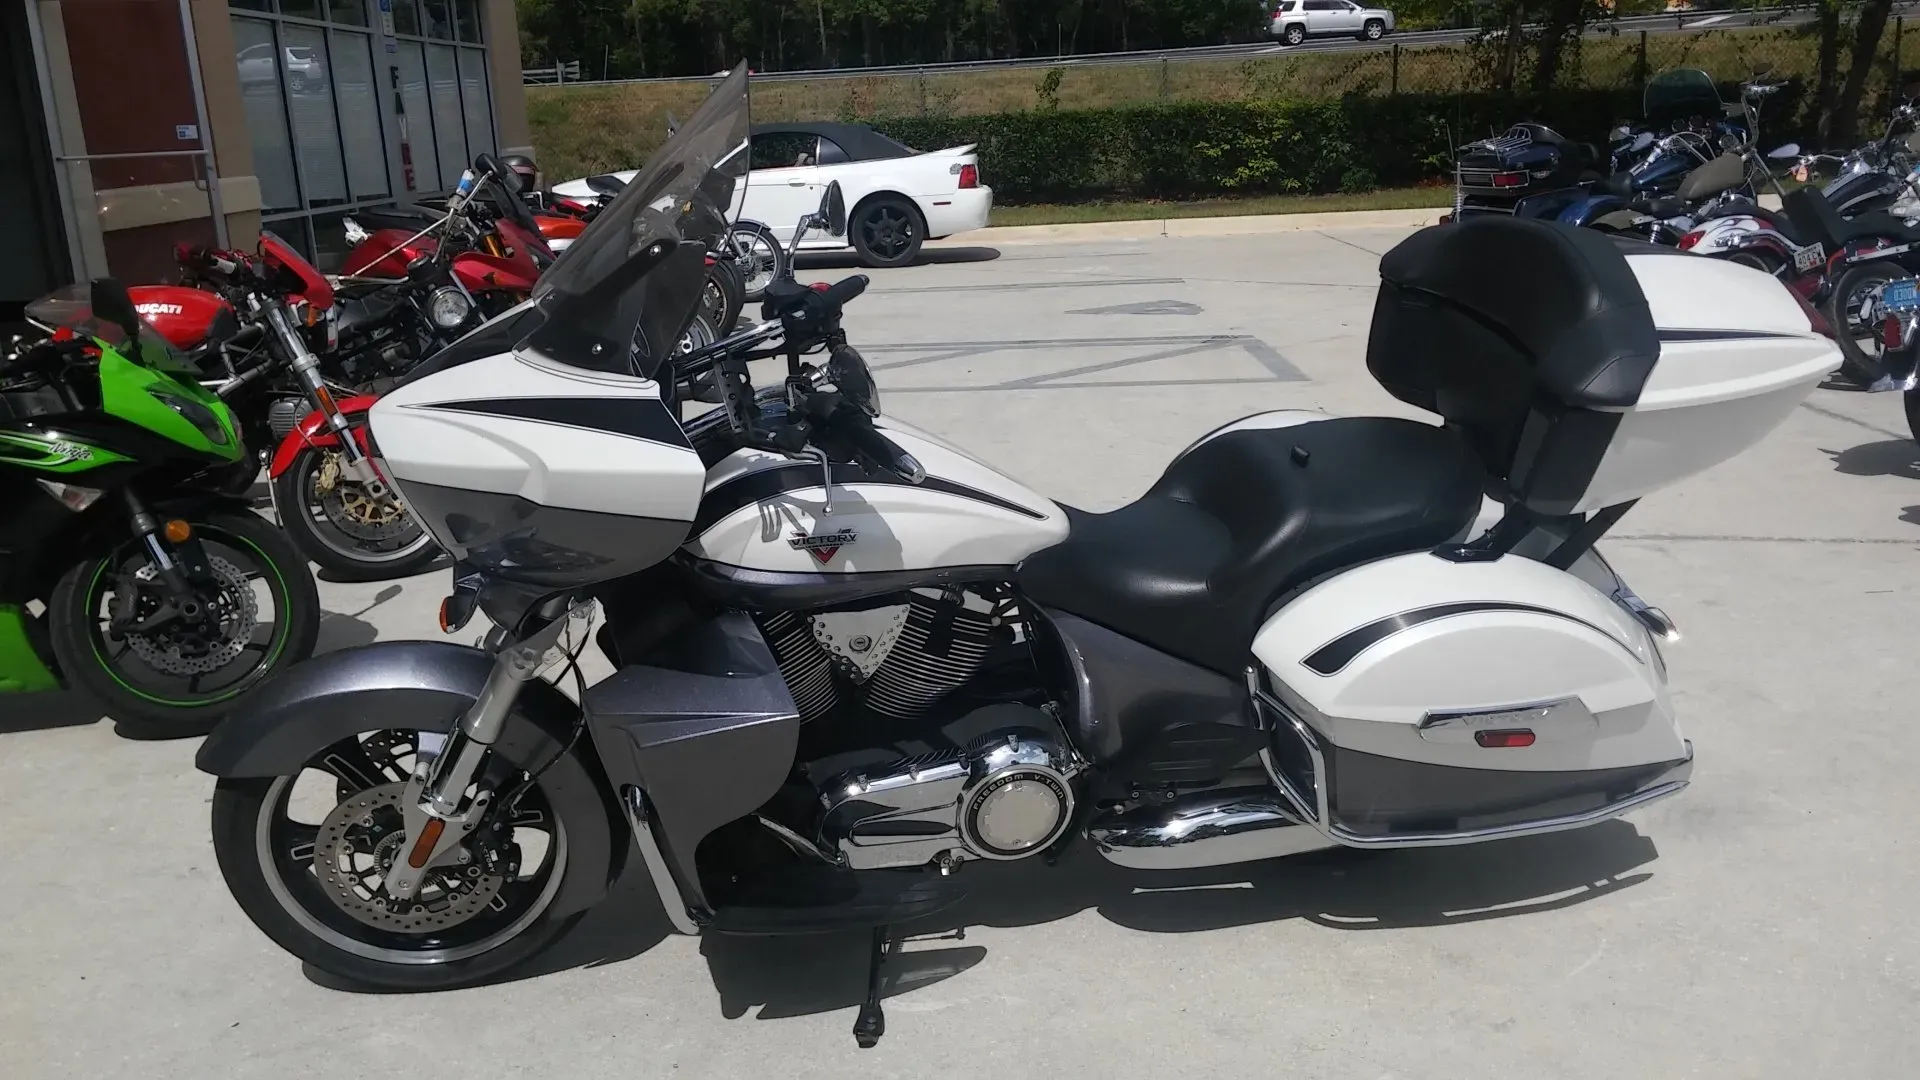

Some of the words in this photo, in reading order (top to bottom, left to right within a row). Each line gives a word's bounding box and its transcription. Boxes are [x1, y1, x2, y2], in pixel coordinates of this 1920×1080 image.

[791, 533, 858, 546] VICTORY
[973, 773, 1024, 811] FREEDOM
[1033, 775, 1064, 799] V-TWIN
